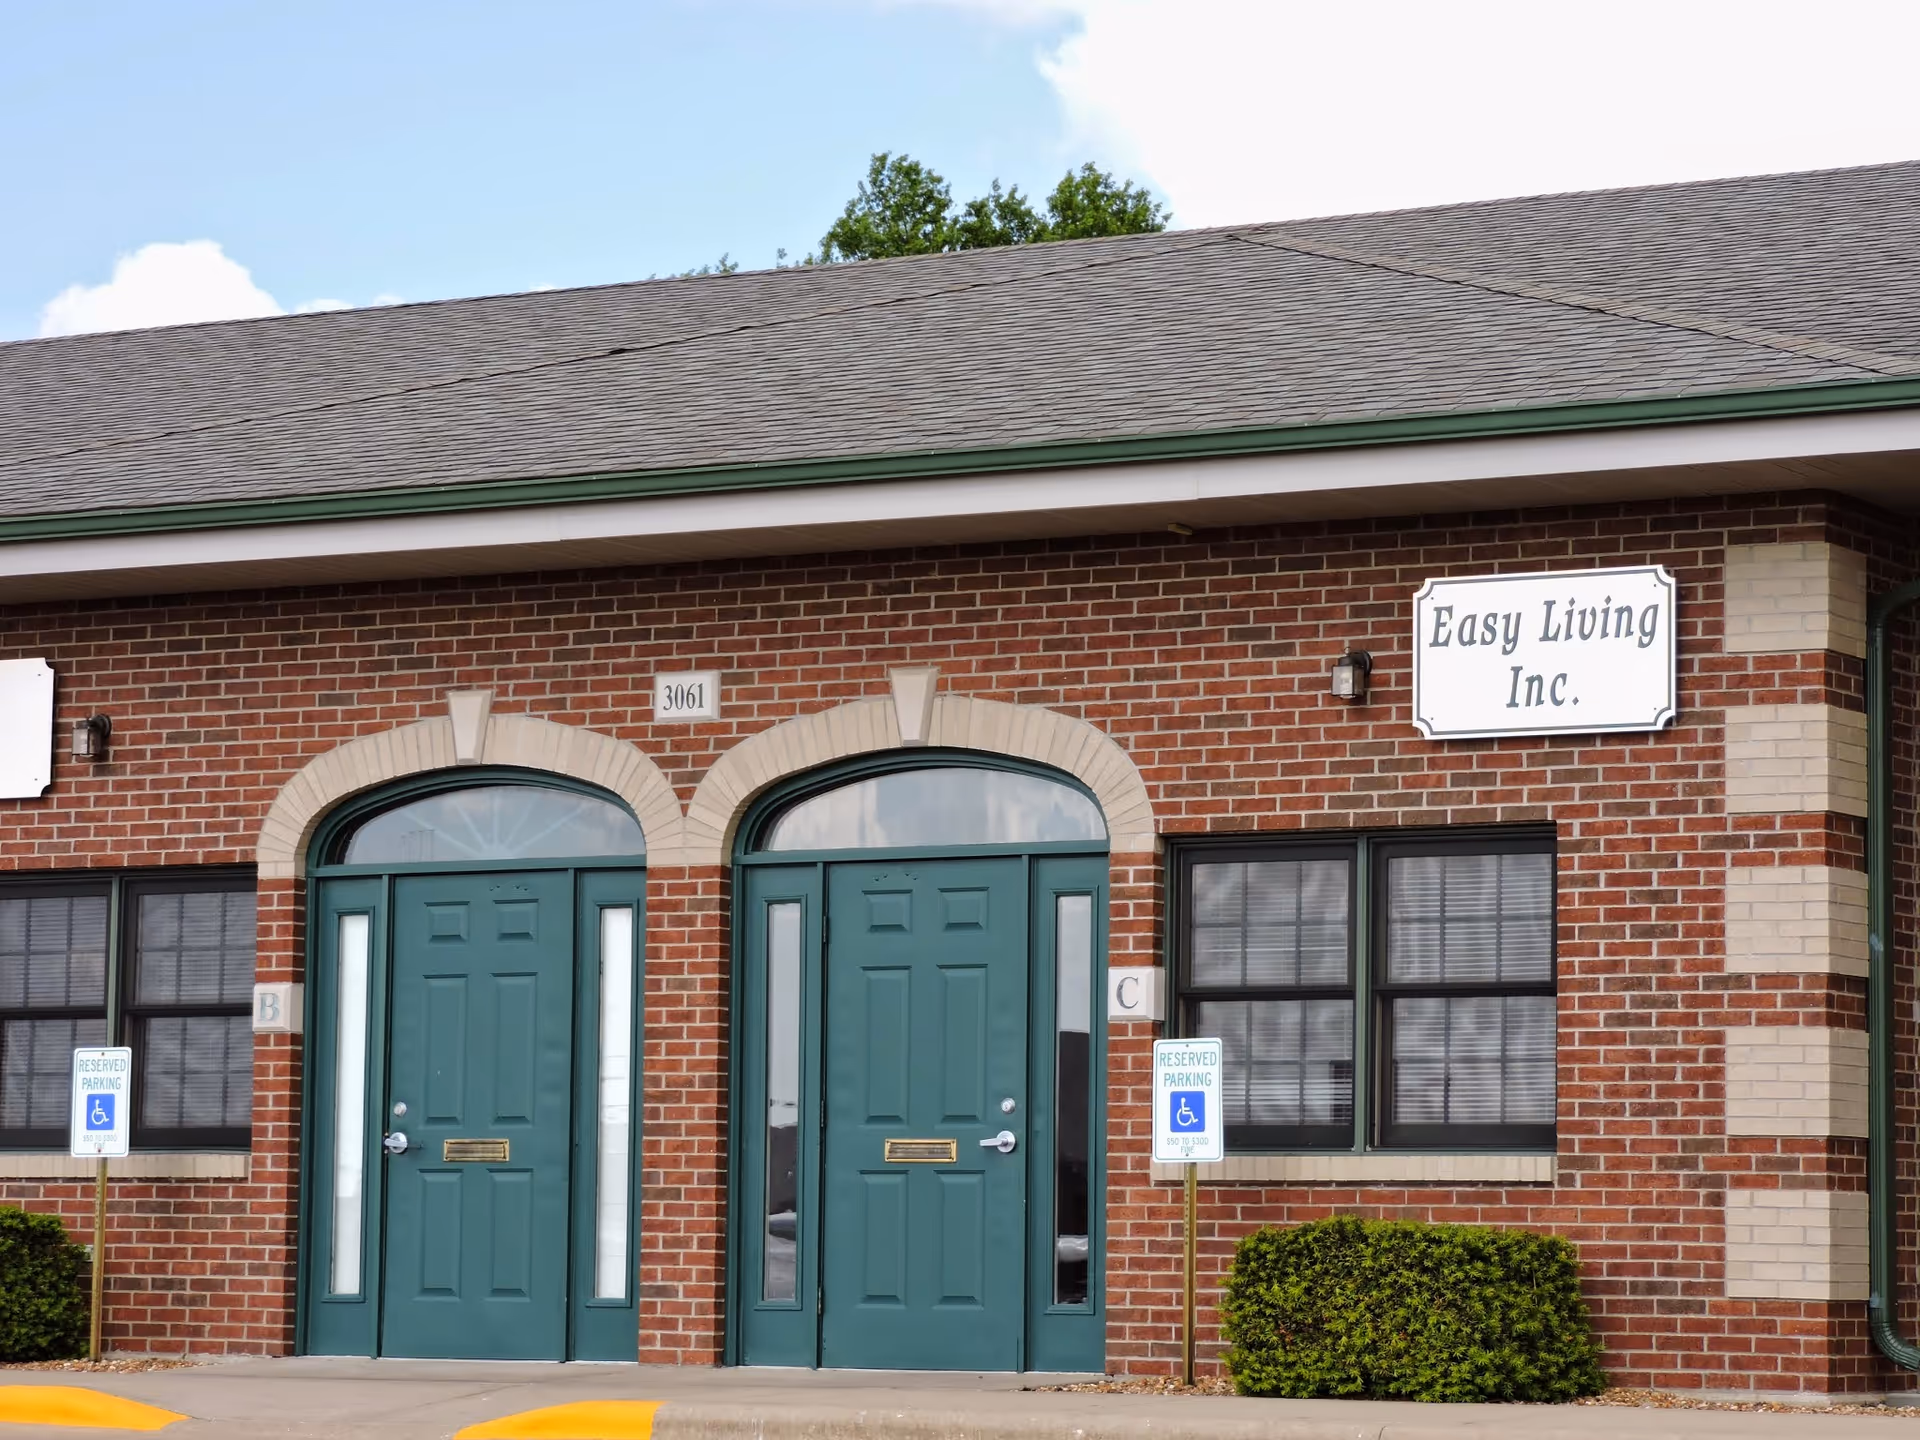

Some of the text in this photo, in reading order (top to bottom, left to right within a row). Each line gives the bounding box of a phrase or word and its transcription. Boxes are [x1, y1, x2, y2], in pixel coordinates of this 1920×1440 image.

[1429, 595, 1659, 655] Easy Living
[663, 683, 704, 711] 3061
[1506, 665, 1579, 708] Inc.
[1116, 976, 1139, 1009] C
[257, 992, 280, 1022] B
[79, 1058, 126, 1072] RESERVED
[1160, 1052, 1217, 1067] RESERVED
[82, 1077, 121, 1090] PARKING
[1163, 1072, 1212, 1087] PARKING
[1166, 1137, 1180, 1146] $50
